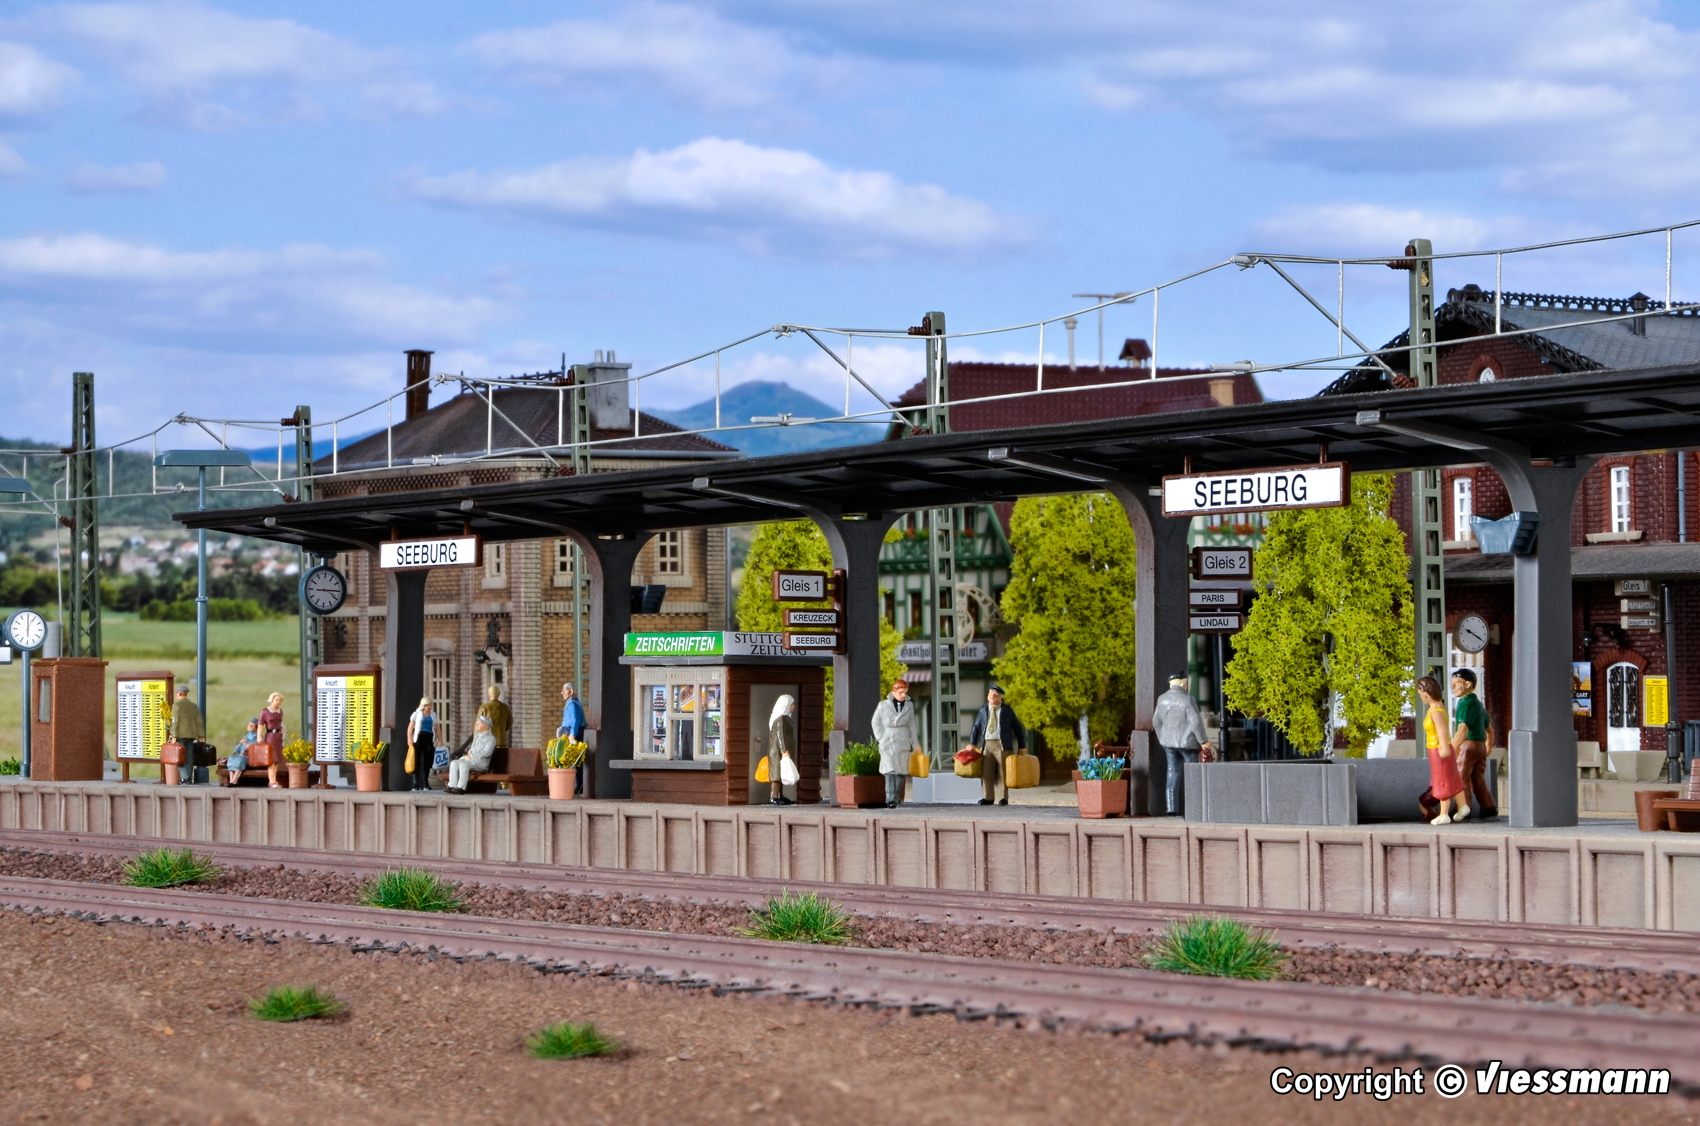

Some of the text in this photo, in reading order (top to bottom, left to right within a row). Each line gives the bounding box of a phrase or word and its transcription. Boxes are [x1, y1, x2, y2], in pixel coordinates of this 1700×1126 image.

[1194, 474, 1307, 507] SEEBURG
[396, 542, 458, 566] SEEBURG
[1204, 555, 1247, 570] Gleis 2
[781, 578, 820, 593] Gleis 1
[1623, 580, 1641, 591] Gleis
[1201, 594, 1225, 603] PARIS
[793, 613, 834, 622] KREUZECK
[1199, 618, 1229, 627] LINDAU
[635, 636, 715, 652] ZEITSCHRIFTEN
[734, 632, 783, 644] STUTTG
[795, 636, 831, 645] SEEBURG
[435, 751, 448, 765] O.K.
